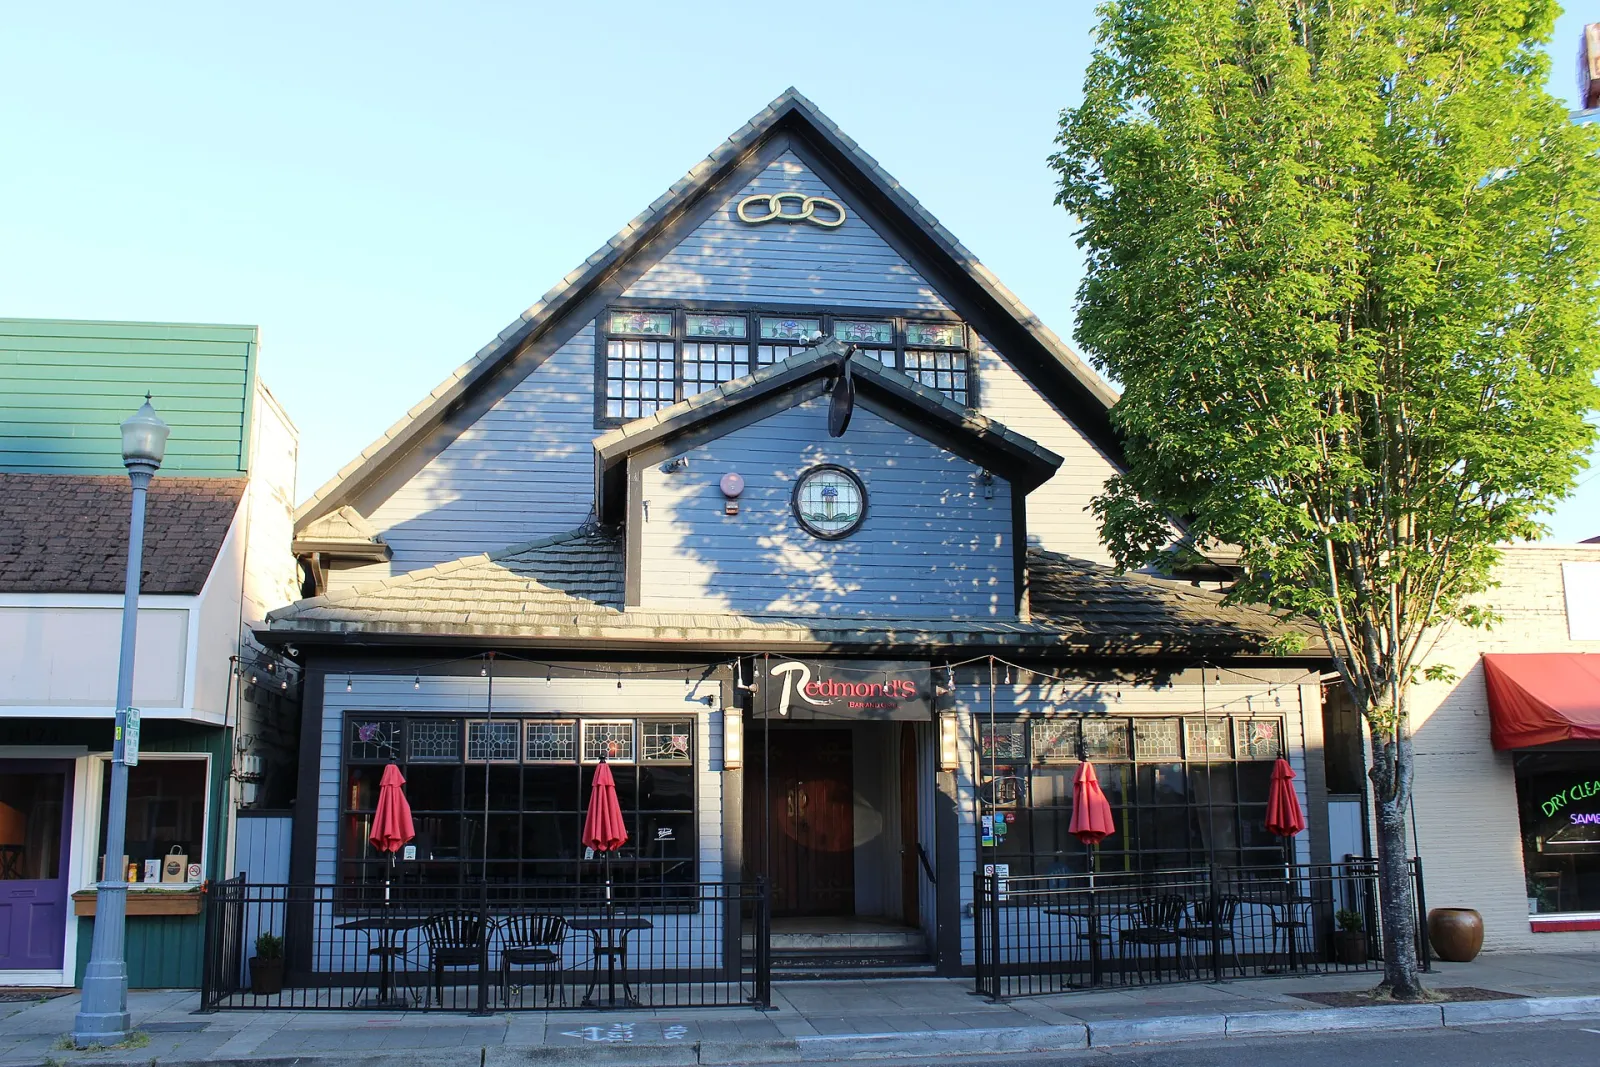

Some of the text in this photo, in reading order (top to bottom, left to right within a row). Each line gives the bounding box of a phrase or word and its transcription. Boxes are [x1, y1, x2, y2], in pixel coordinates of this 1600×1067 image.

[770, 661, 915, 716] Redmond's
[1541, 780, 1600, 818] DRY CLEA
[1570, 813, 1600, 825] SAME
